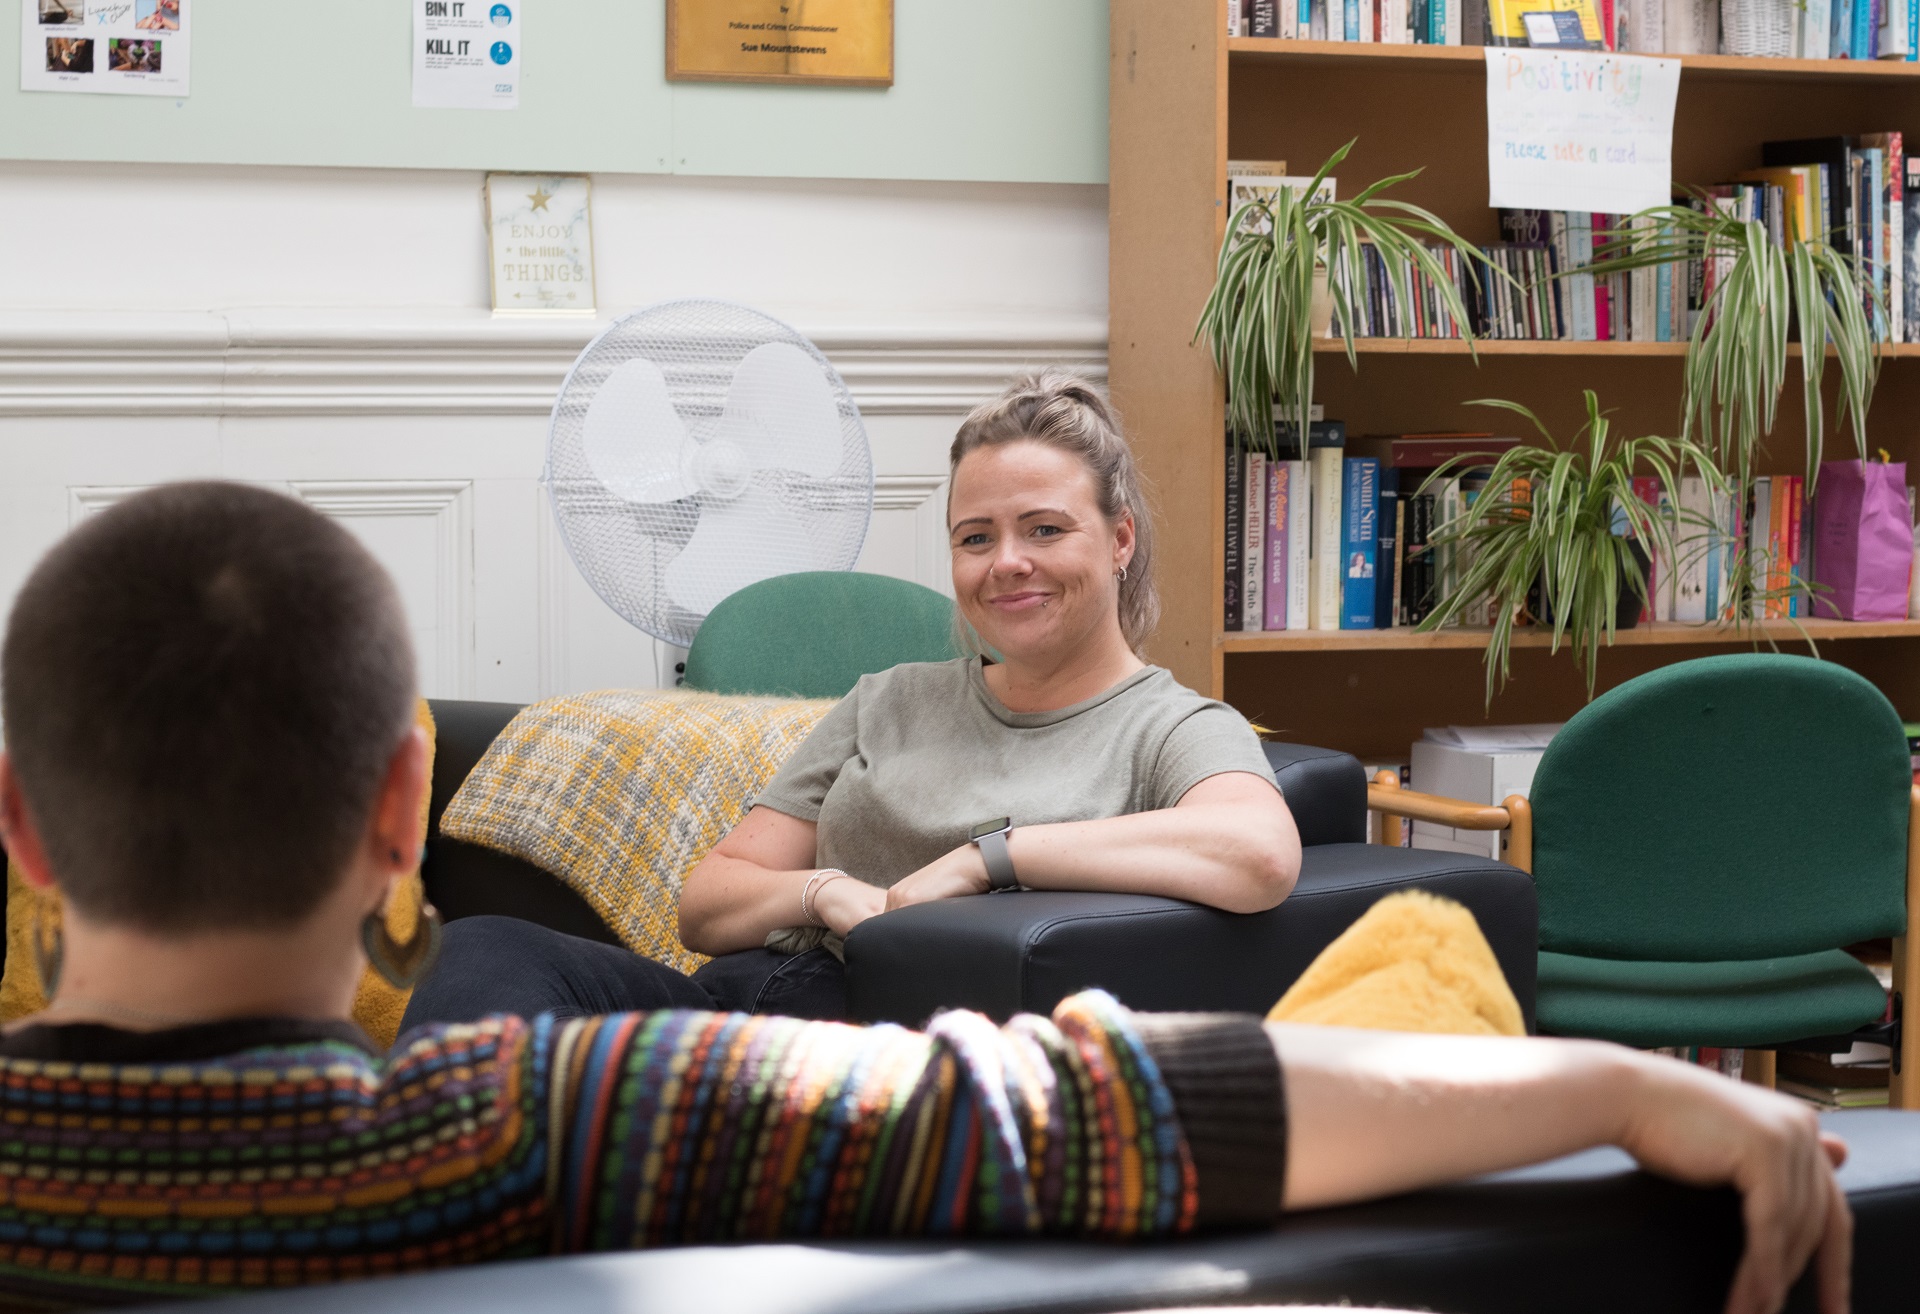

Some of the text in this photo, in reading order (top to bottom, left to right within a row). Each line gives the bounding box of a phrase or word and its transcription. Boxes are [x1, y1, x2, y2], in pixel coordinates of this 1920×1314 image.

[425, 1, 465, 18] BIN IT
[780, 5, 789, 14] by
[1265, 3, 1273, 28] STEVE
[728, 21, 839, 33] Police and Crime Commissioner
[426, 39, 471, 55] KILL IT
[741, 42, 827, 54] Sue Mountstevens
[1506, 54, 1642, 106] Positivity
[1553, 141, 1584, 163] take
[1589, 147, 1598, 163] a
[1606, 142, 1636, 165] card
[511, 224, 573, 239] ENJOY
[519, 245, 566, 258] the little
[503, 263, 585, 282] THINGS
[1248, 458, 1262, 549] Mandasue HELLER
[1269, 476, 1278, 526] ON TOUR
[1359, 463, 1377, 542] DANIELLE STEEL
[1226, 455, 1239, 573] GERI HALLIWELL
[1272, 539, 1281, 584] ZOE SUGG
[1246, 554, 1258, 609] The Club
